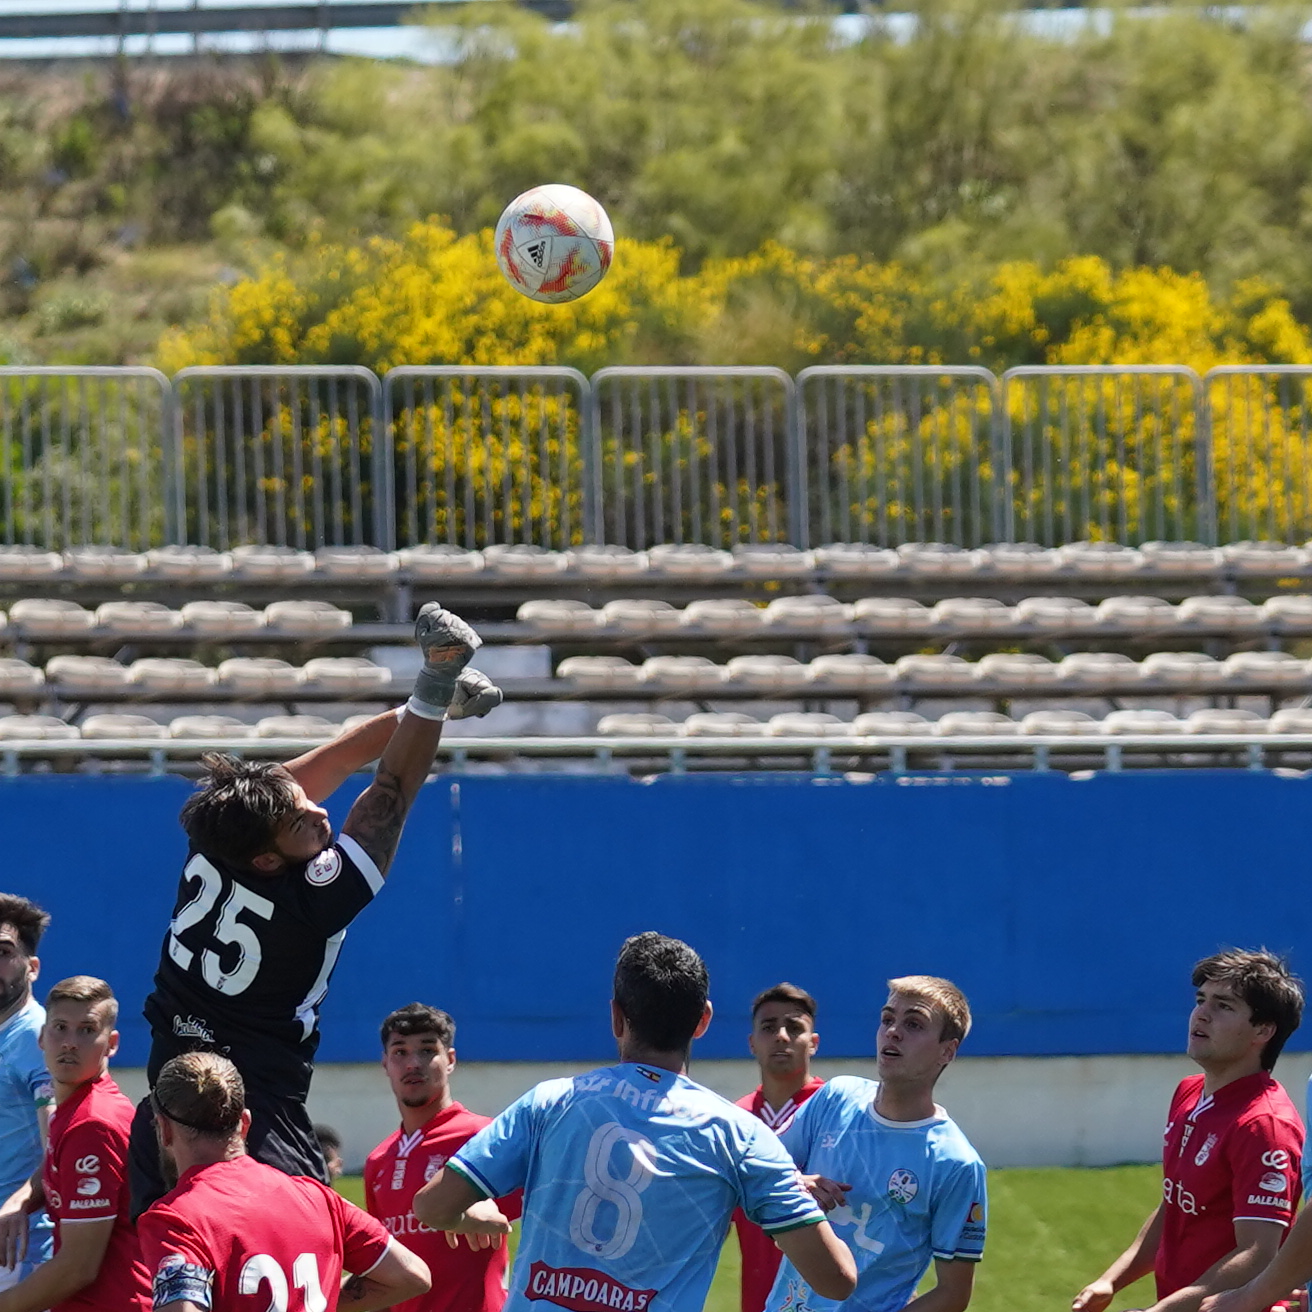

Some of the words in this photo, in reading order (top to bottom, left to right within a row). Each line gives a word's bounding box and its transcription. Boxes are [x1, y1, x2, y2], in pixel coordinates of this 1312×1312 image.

[168, 852, 275, 997] 25
[568, 1120, 657, 1261] 8
[532, 1270, 651, 1312] CAMPOARAS
